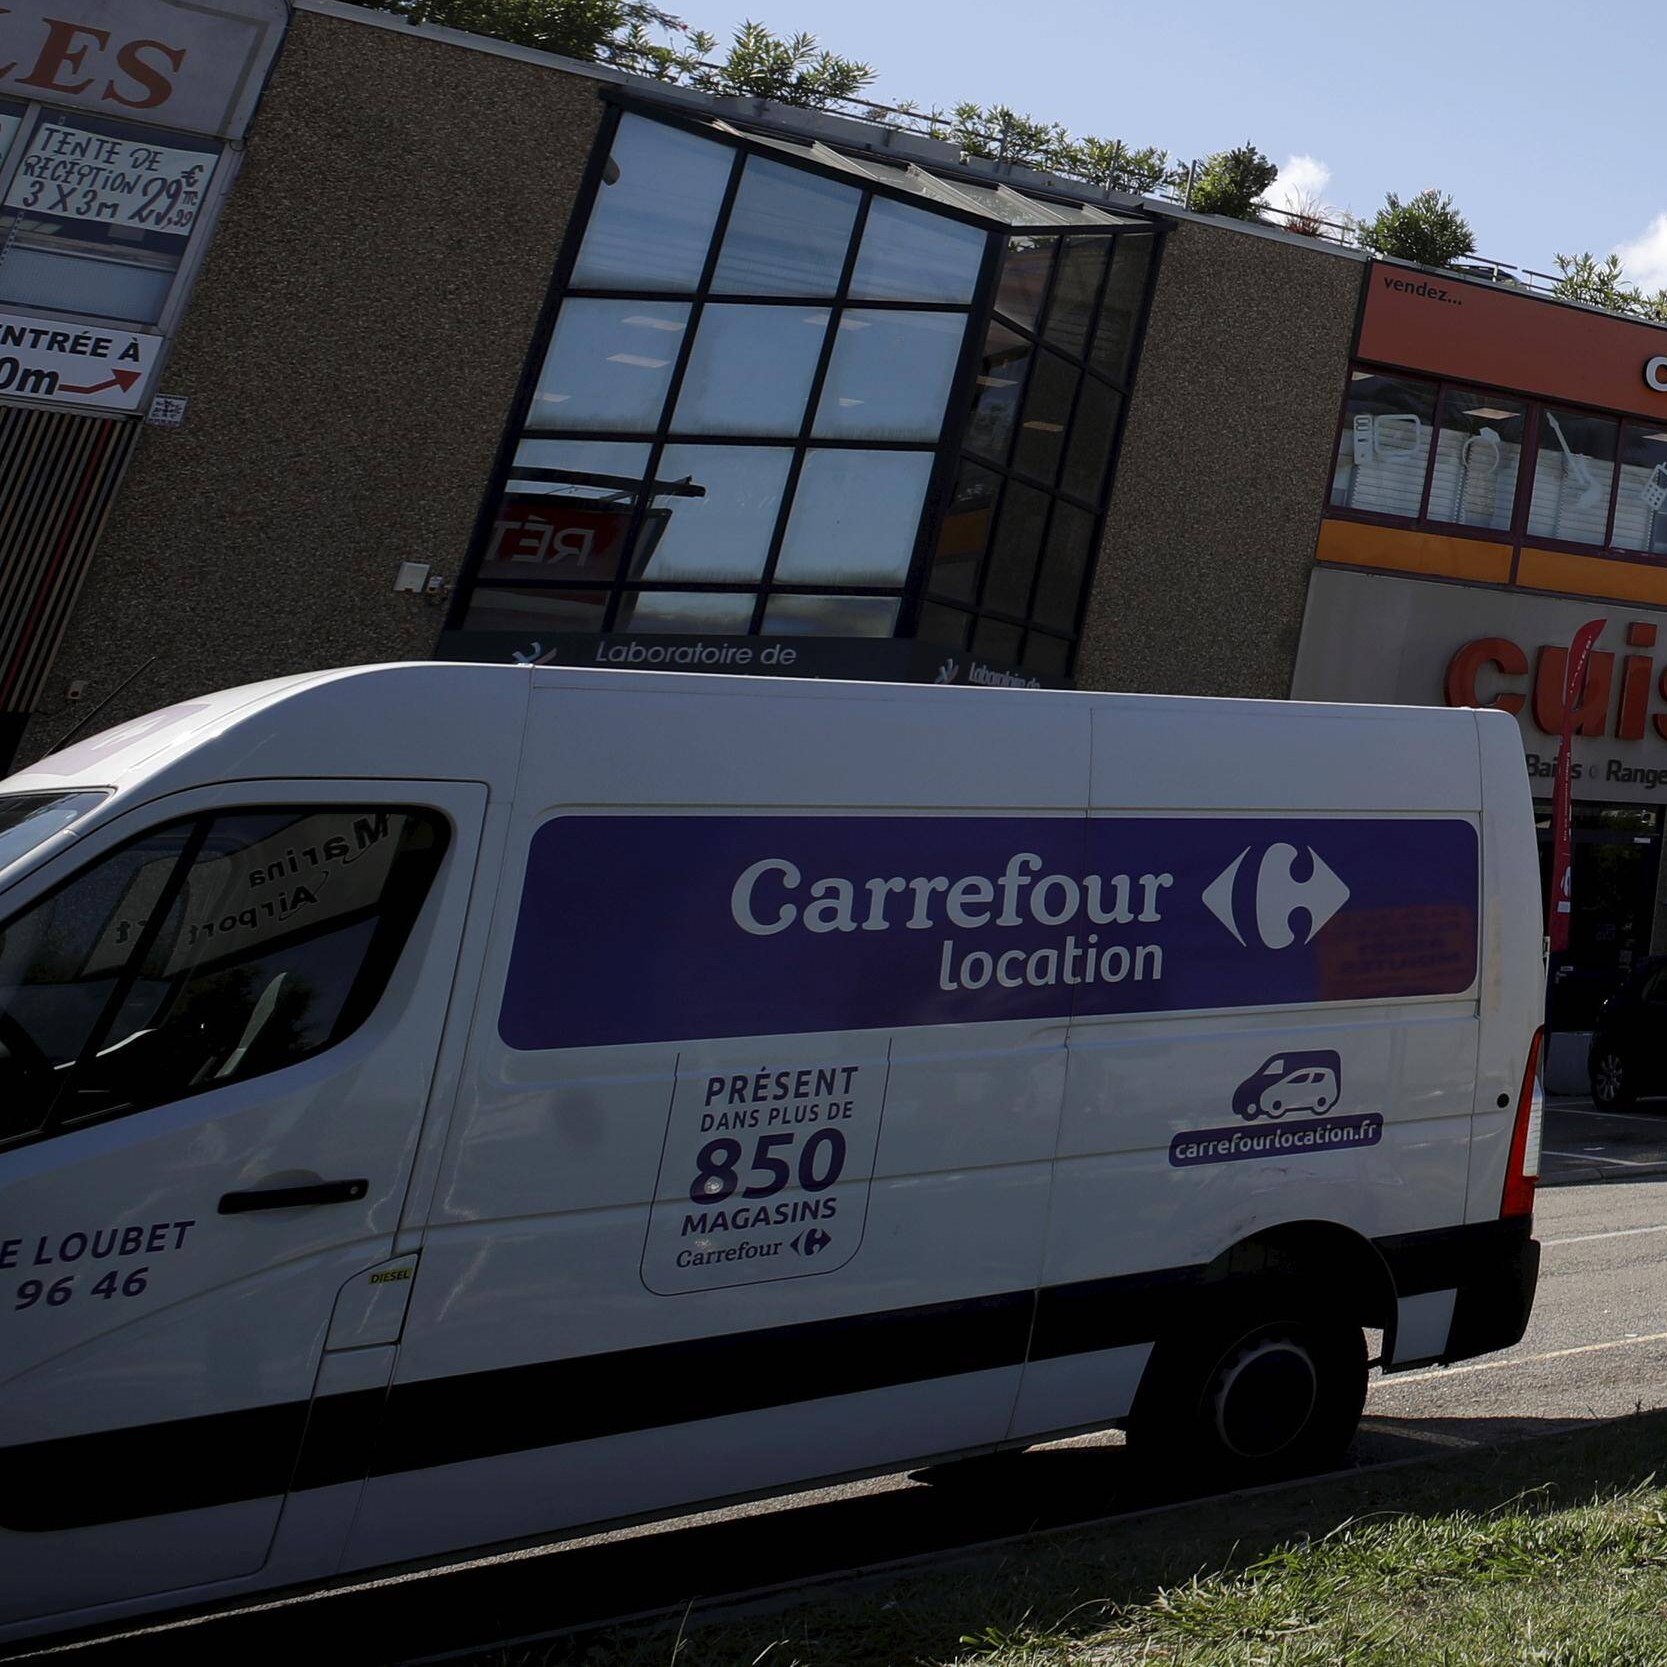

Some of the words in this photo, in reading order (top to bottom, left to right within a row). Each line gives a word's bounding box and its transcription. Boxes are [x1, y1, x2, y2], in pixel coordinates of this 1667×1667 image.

[40, 127, 122, 165] TENTE
[129, 147, 164, 172] DE
[23, 180, 45, 207] 3
[0, 323, 112, 358] NTRÉE
[118, 337, 140, 362] À
[596, 640, 752, 665] Laboratoire
[760, 644, 797, 665] de
[1525, 754, 1582, 779] Bais
[730, 852, 1174, 935] Carrefour
[939, 934, 1164, 990] location
[704, 1066, 859, 1107] PRÉSENT
[700, 1109, 760, 1132] DANS
[768, 1104, 819, 1126] PLUS
[827, 1101, 854, 1120] DE
[1175, 1120, 1377, 1159] carrefourlocation.fr
[689, 1127, 847, 1205] 850
[681, 1197, 837, 1236] MAGASINS
[34, 1221, 196, 1266] LOUBET
[676, 1240, 784, 1268] Carrefour
[15, 1275, 74, 1311] 96
[90, 1267, 149, 1300] 46
[370, 1269, 410, 1284] DIESEL
